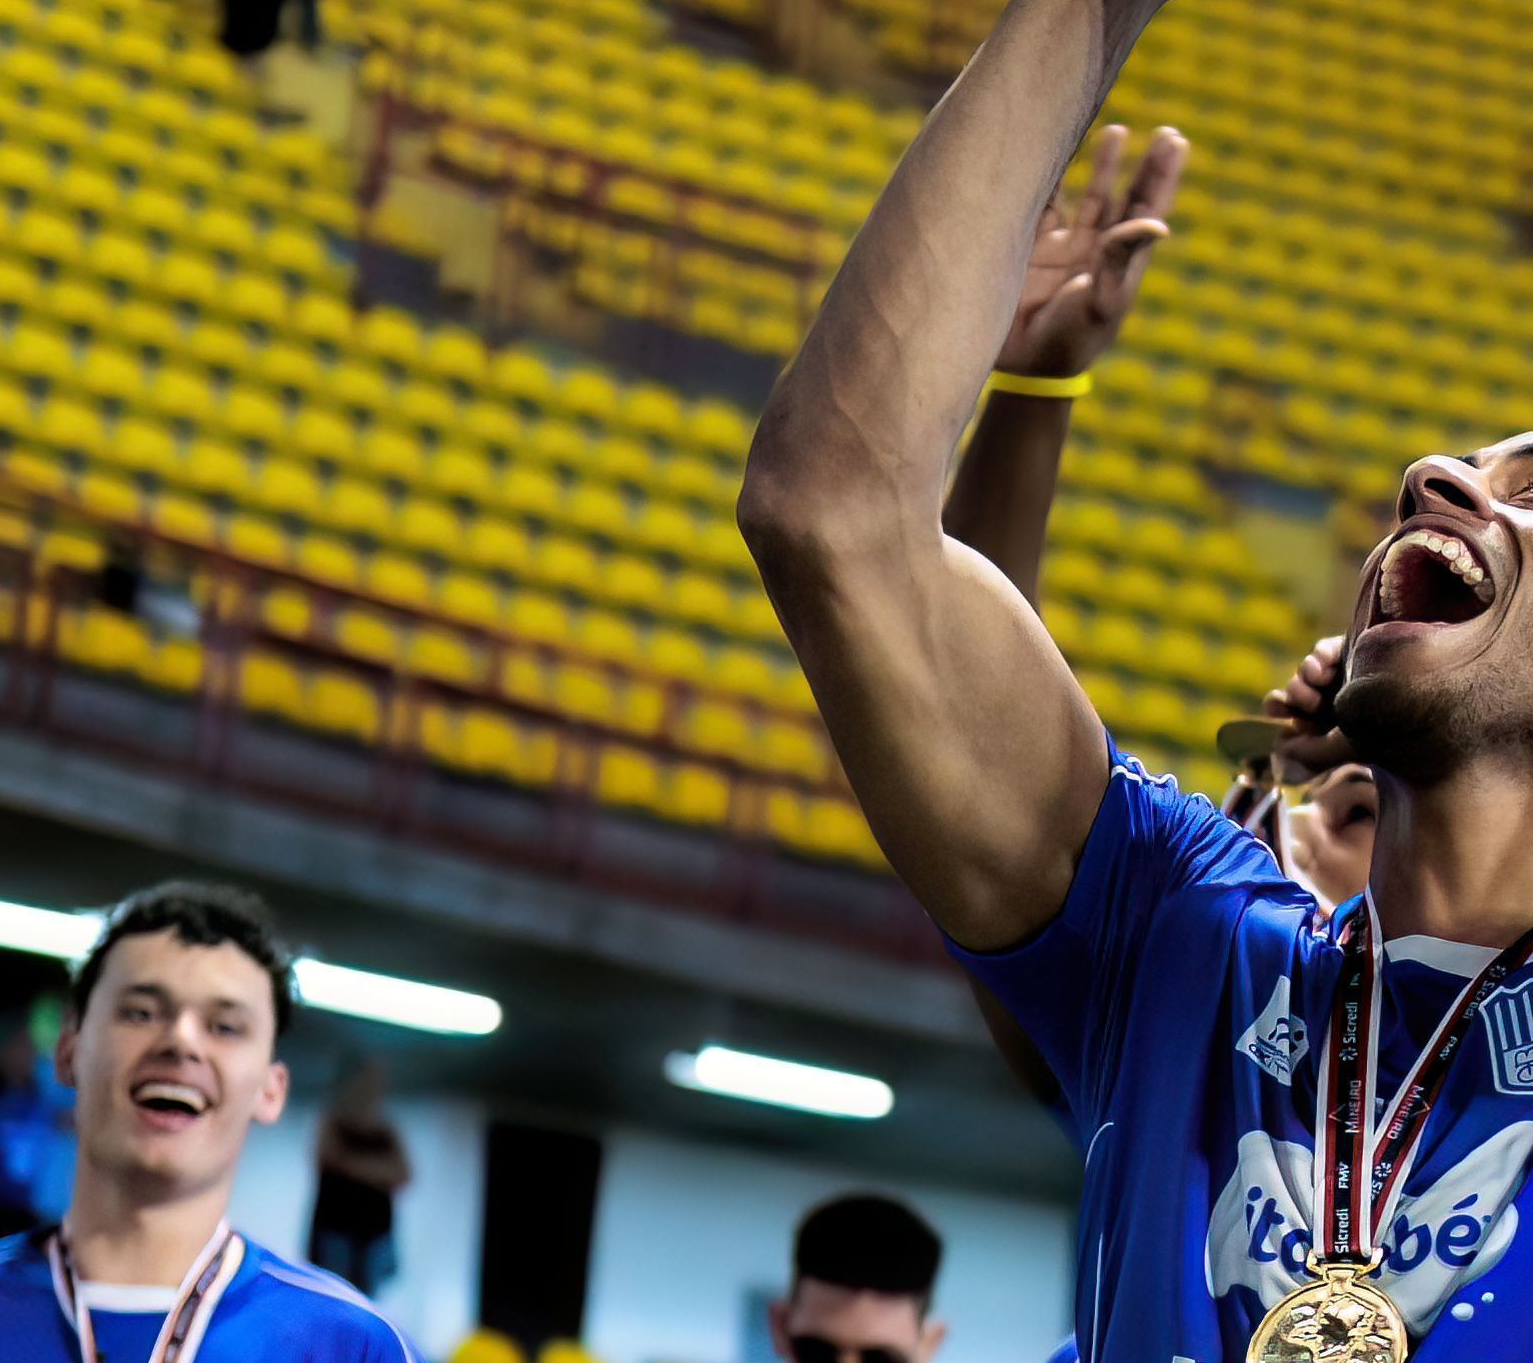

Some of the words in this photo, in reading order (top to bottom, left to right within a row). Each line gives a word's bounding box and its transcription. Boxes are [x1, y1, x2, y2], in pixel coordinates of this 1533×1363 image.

[1342, 1001, 1359, 1044] Sicredi
[1338, 1161, 1350, 1189] FMV
[1334, 1207, 1349, 1253] Sicredi
